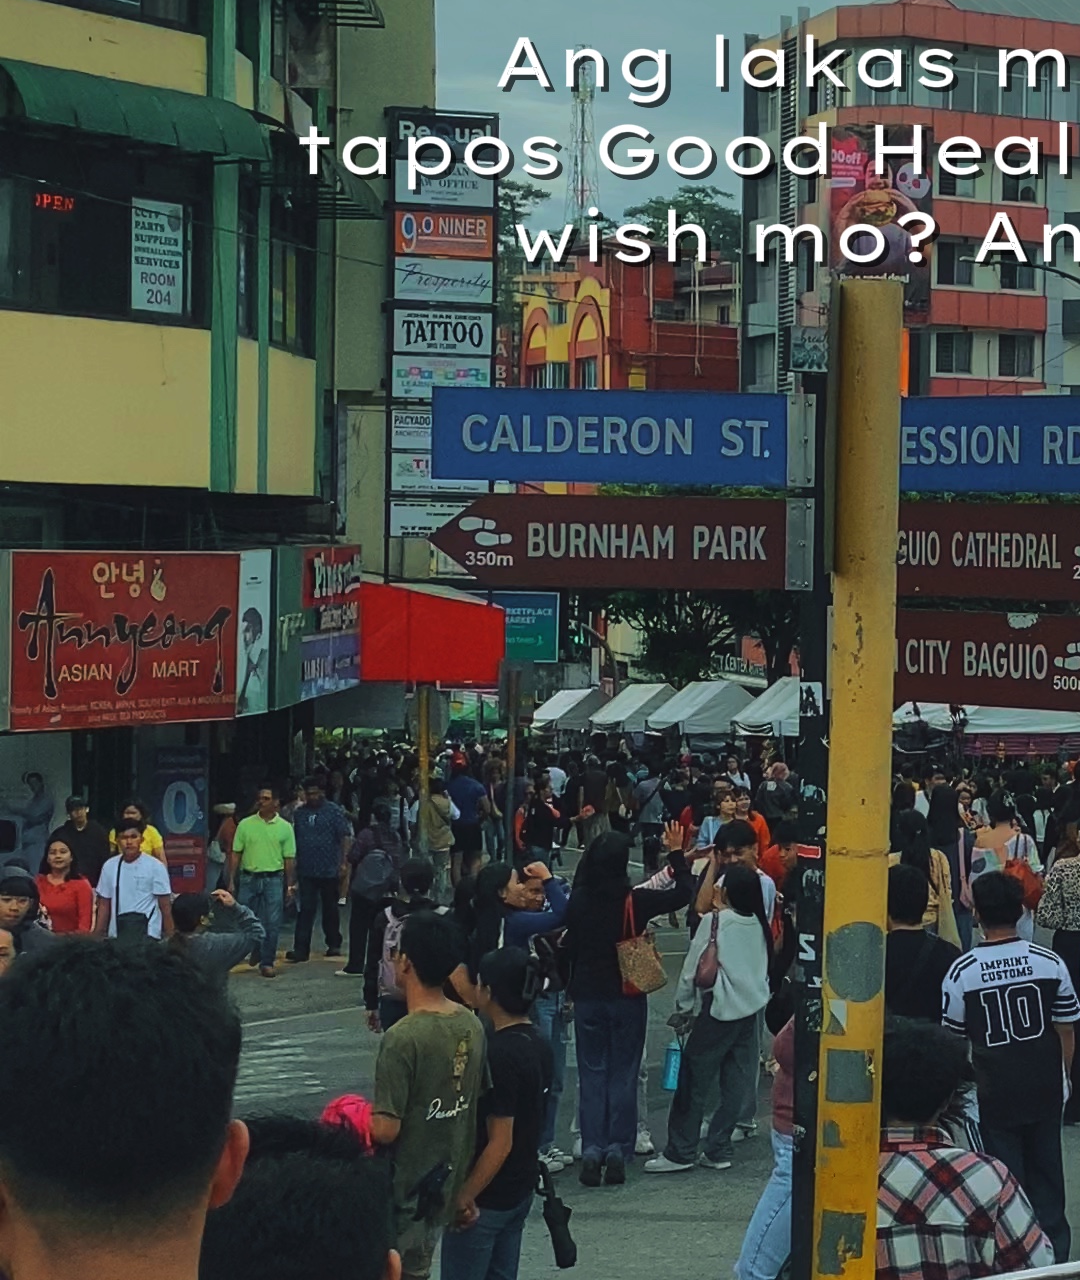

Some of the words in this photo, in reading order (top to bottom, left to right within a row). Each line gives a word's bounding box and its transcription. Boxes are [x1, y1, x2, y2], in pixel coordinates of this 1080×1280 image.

[438, 180, 479, 190] OFFICE
[134, 220, 166, 232] PARTS
[438, 216, 488, 237] NINER
[134, 233, 179, 248] SUPPLIES
[134, 255, 181, 270] SERVICES
[140, 271, 176, 287] ROOM
[401, 263, 491, 295] Prosperity
[146, 288, 172, 306] 204
[401, 320, 484, 348] TATTOO
[462, 414, 692, 455] CALDERON
[720, 419, 770, 458] ST.
[901, 425, 1020, 465] ESSION
[527, 522, 674, 560] BURNHAM
[693, 525, 767, 560] PARK
[951, 531, 1062, 569] CATHEDRAL
[465, 551, 514, 567] 350m
[92, 559, 145, 599] 안녕
[18, 567, 232, 700] Annyeong
[58, 663, 112, 682] ASIAN
[152, 659, 200, 679] MART
[905, 638, 951, 675] CITY
[963, 640, 1048, 681] BAGUIO
[980, 956, 1029, 972] IMPRINT
[981, 966, 1034, 983] CUSTOMS
[980, 982, 1045, 1047] 10
